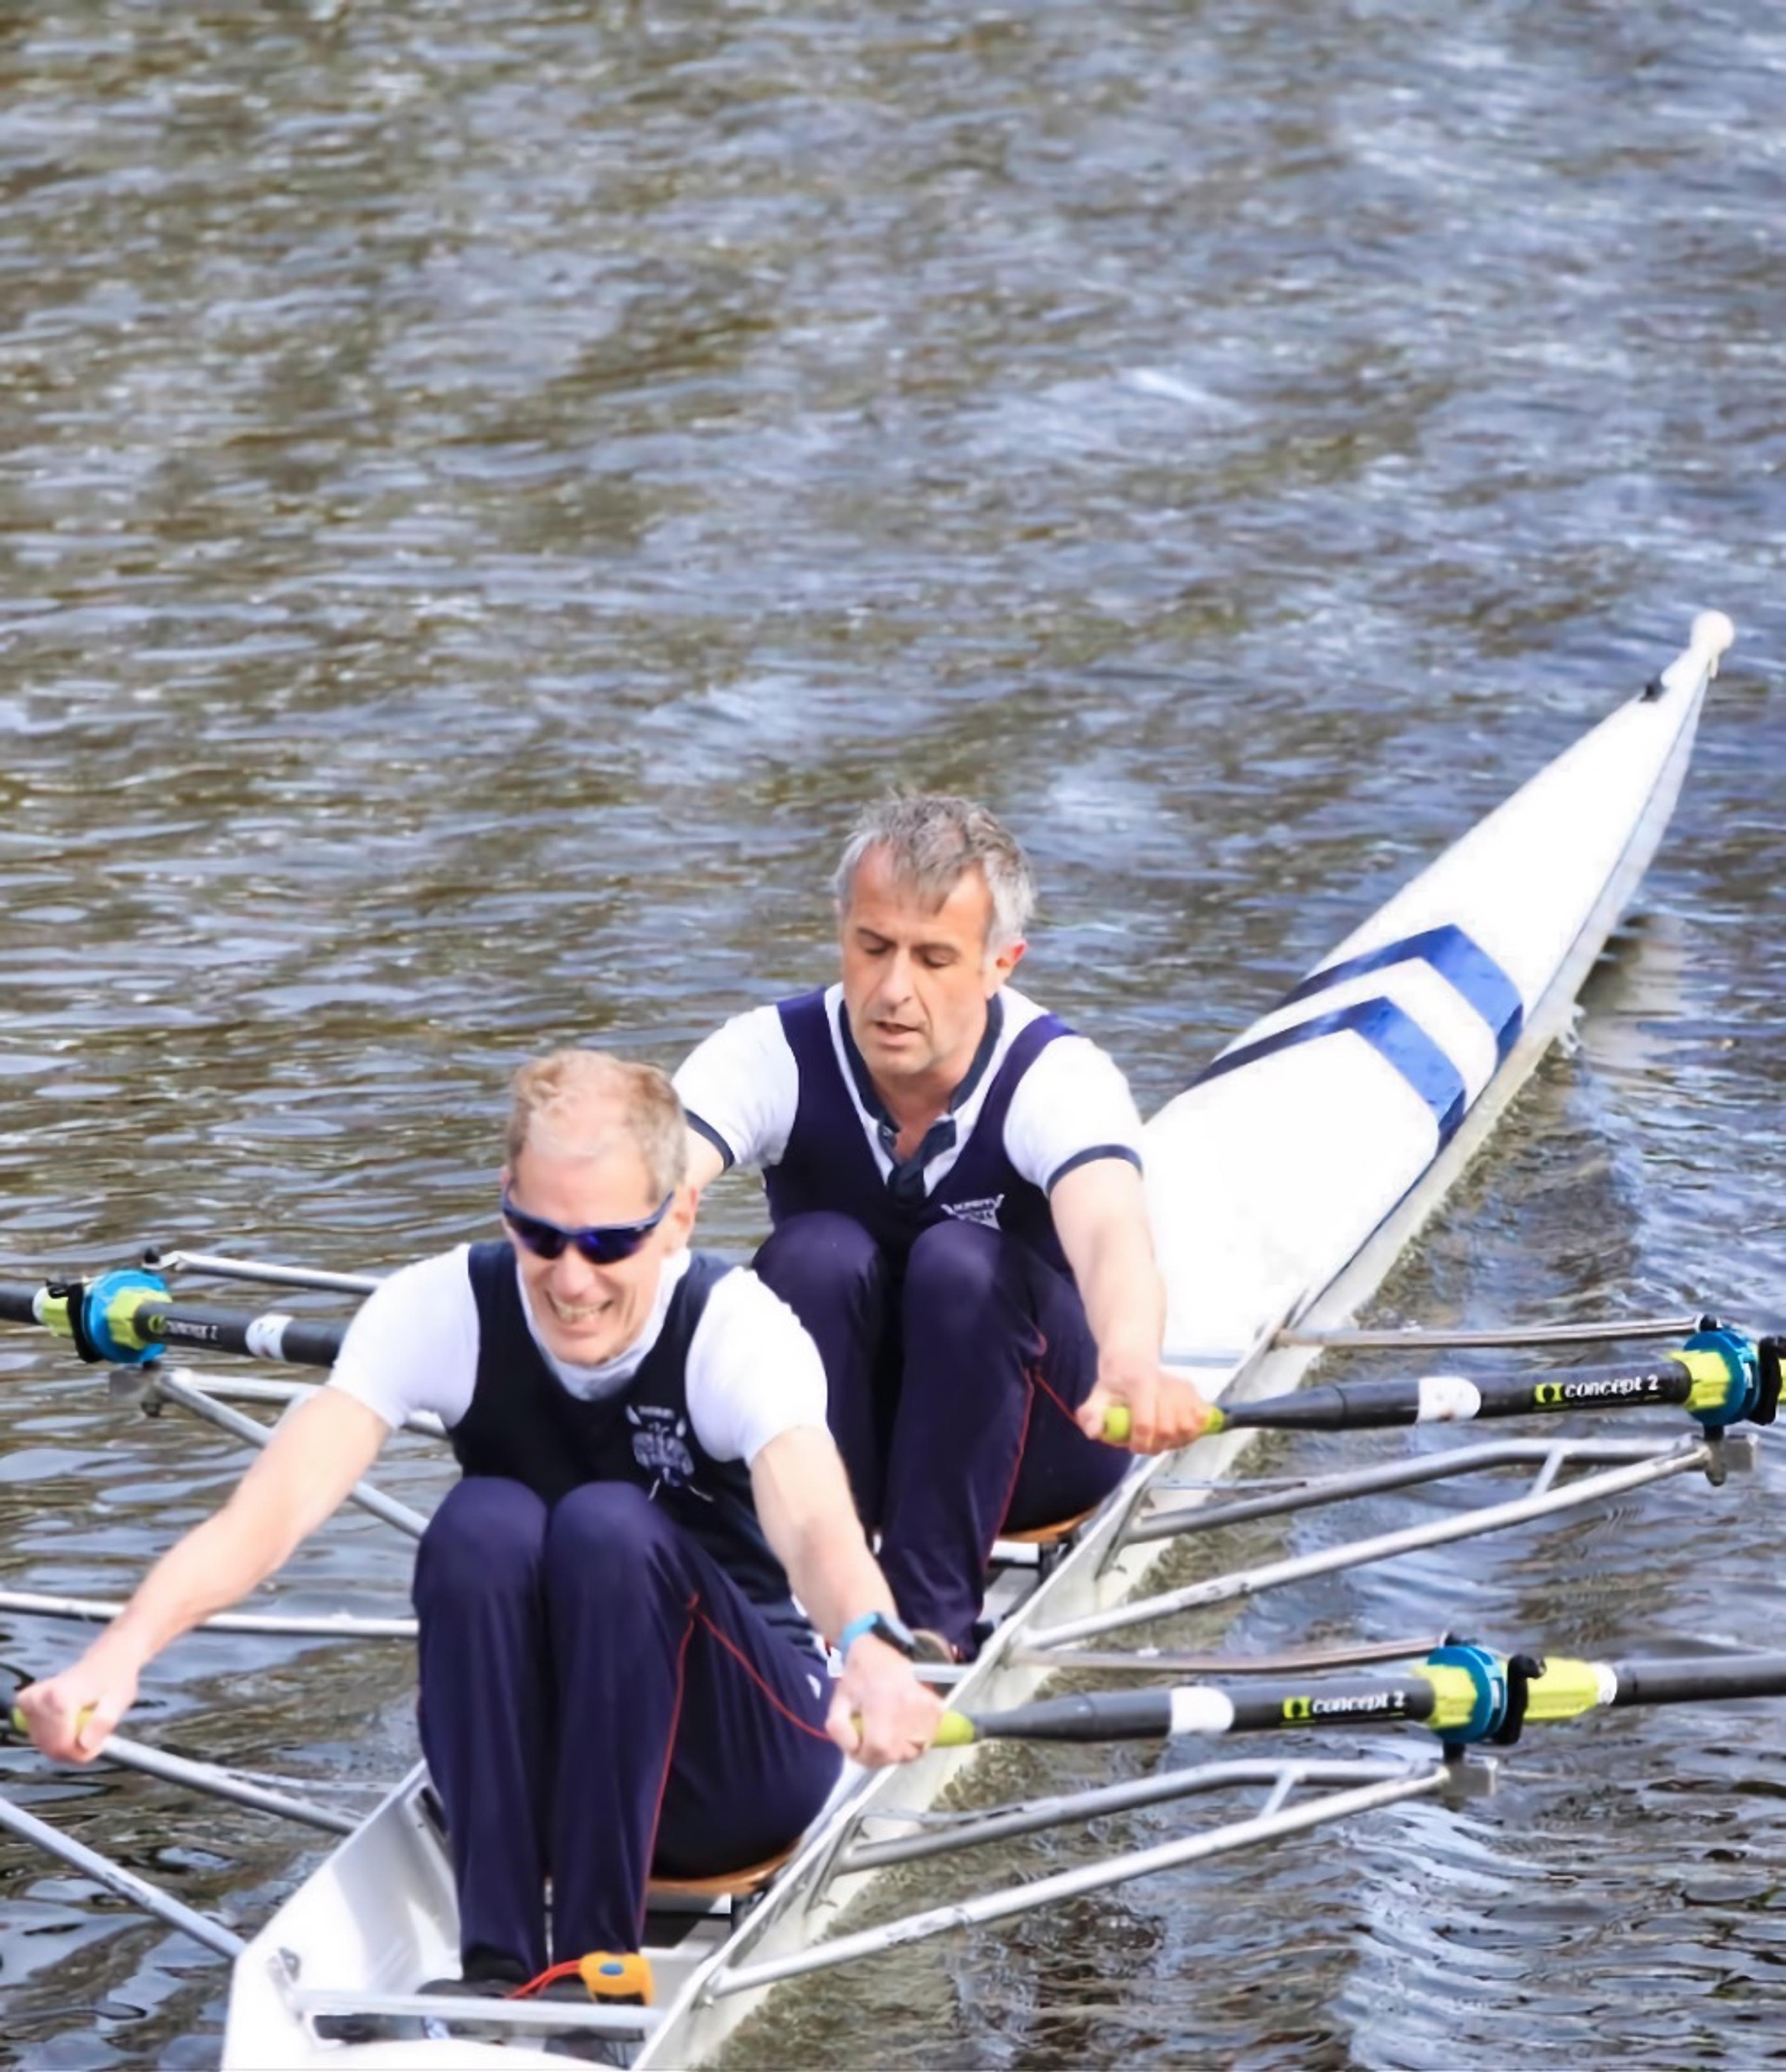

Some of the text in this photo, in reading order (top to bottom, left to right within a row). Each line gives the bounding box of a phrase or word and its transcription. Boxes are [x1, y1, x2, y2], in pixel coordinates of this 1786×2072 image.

[1565, 1374, 1659, 1398] concept 2
[1393, 1691, 1405, 1708] 2
